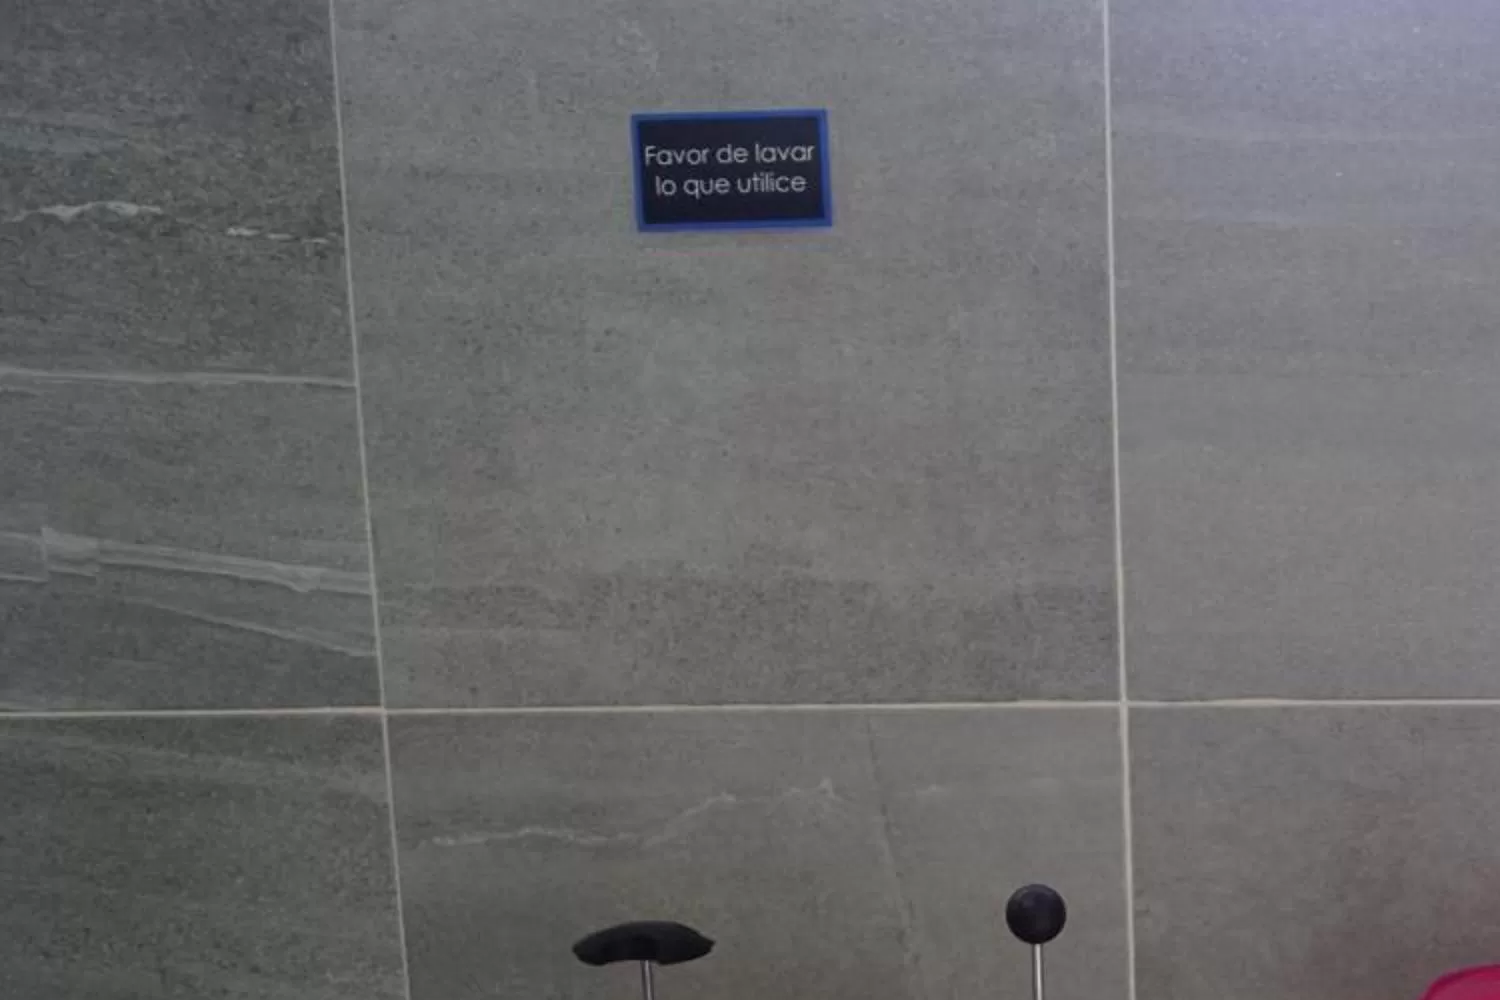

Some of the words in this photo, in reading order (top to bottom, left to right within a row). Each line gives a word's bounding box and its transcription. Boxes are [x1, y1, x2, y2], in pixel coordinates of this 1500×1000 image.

[644, 145, 710, 167] Favor
[715, 144, 748, 164] de
[755, 142, 815, 164] lavar
[655, 175, 677, 196] lo
[683, 177, 730, 199] que
[737, 172, 808, 194] utilice
